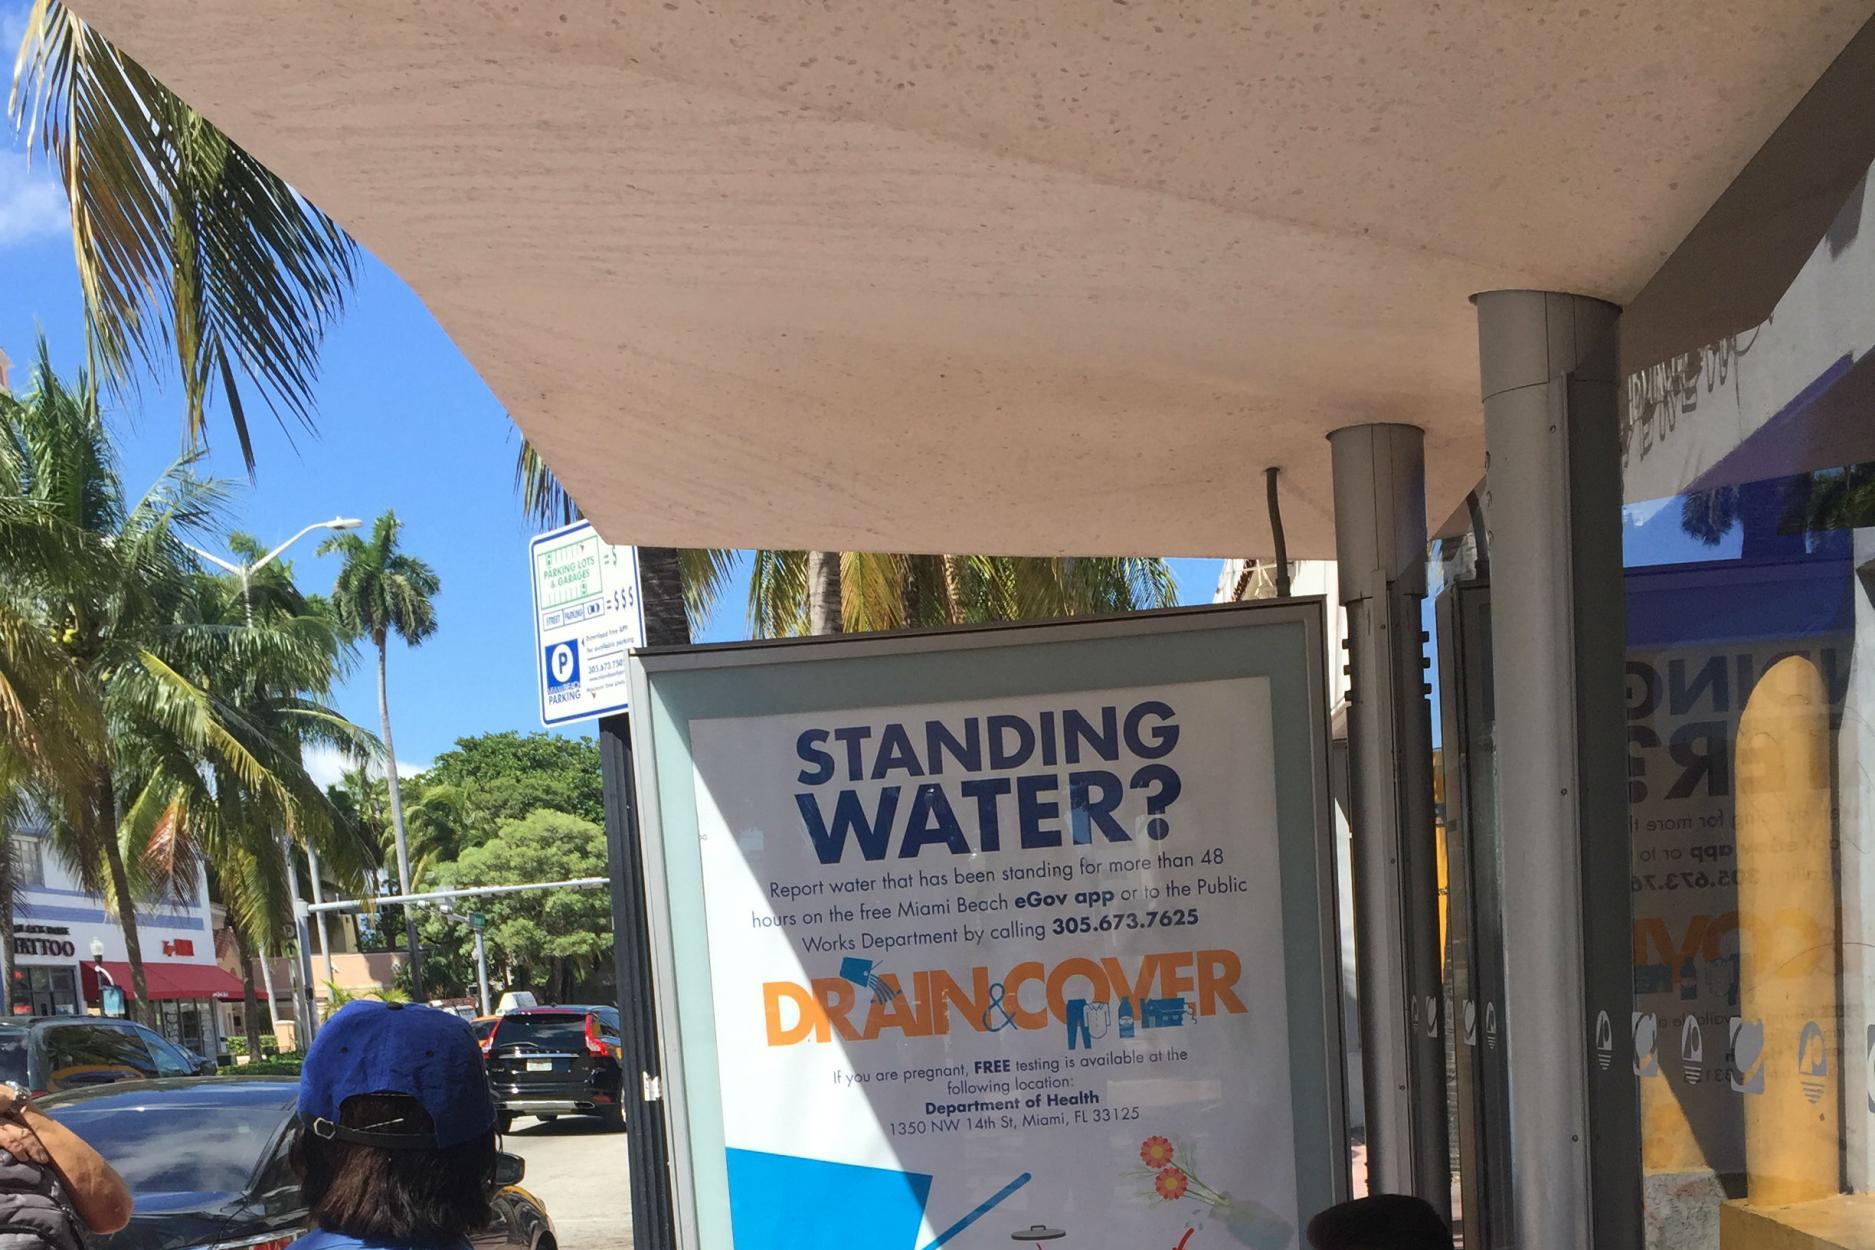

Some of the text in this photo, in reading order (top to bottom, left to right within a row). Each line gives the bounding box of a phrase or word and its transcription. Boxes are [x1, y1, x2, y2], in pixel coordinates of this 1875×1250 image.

[543, 555, 595, 580] PARKING LOTS
[557, 569, 590, 586] GARAGES
[558, 651, 568, 675] P
[549, 689, 581, 706] PARKING
[795, 701, 1180, 786] STANDING
[795, 764, 1182, 865] WATER?
[770, 848, 1224, 902] Report water that has been standing for more than 48
[751, 875, 1248, 929] hours on the free Miami Beach eGov app or to the Public
[801, 909, 1199, 953] Works Department by calling 305.673.7625
[833, 1047, 1188, 1087] If you are pregnant, FREE testing is available at the
[947, 1076, 1075, 1096] following location:
[925, 1090, 1100, 1118] Department of Health
[890, 1106, 1140, 1136] 1350 NW 14th St, Miami, FL 33125
